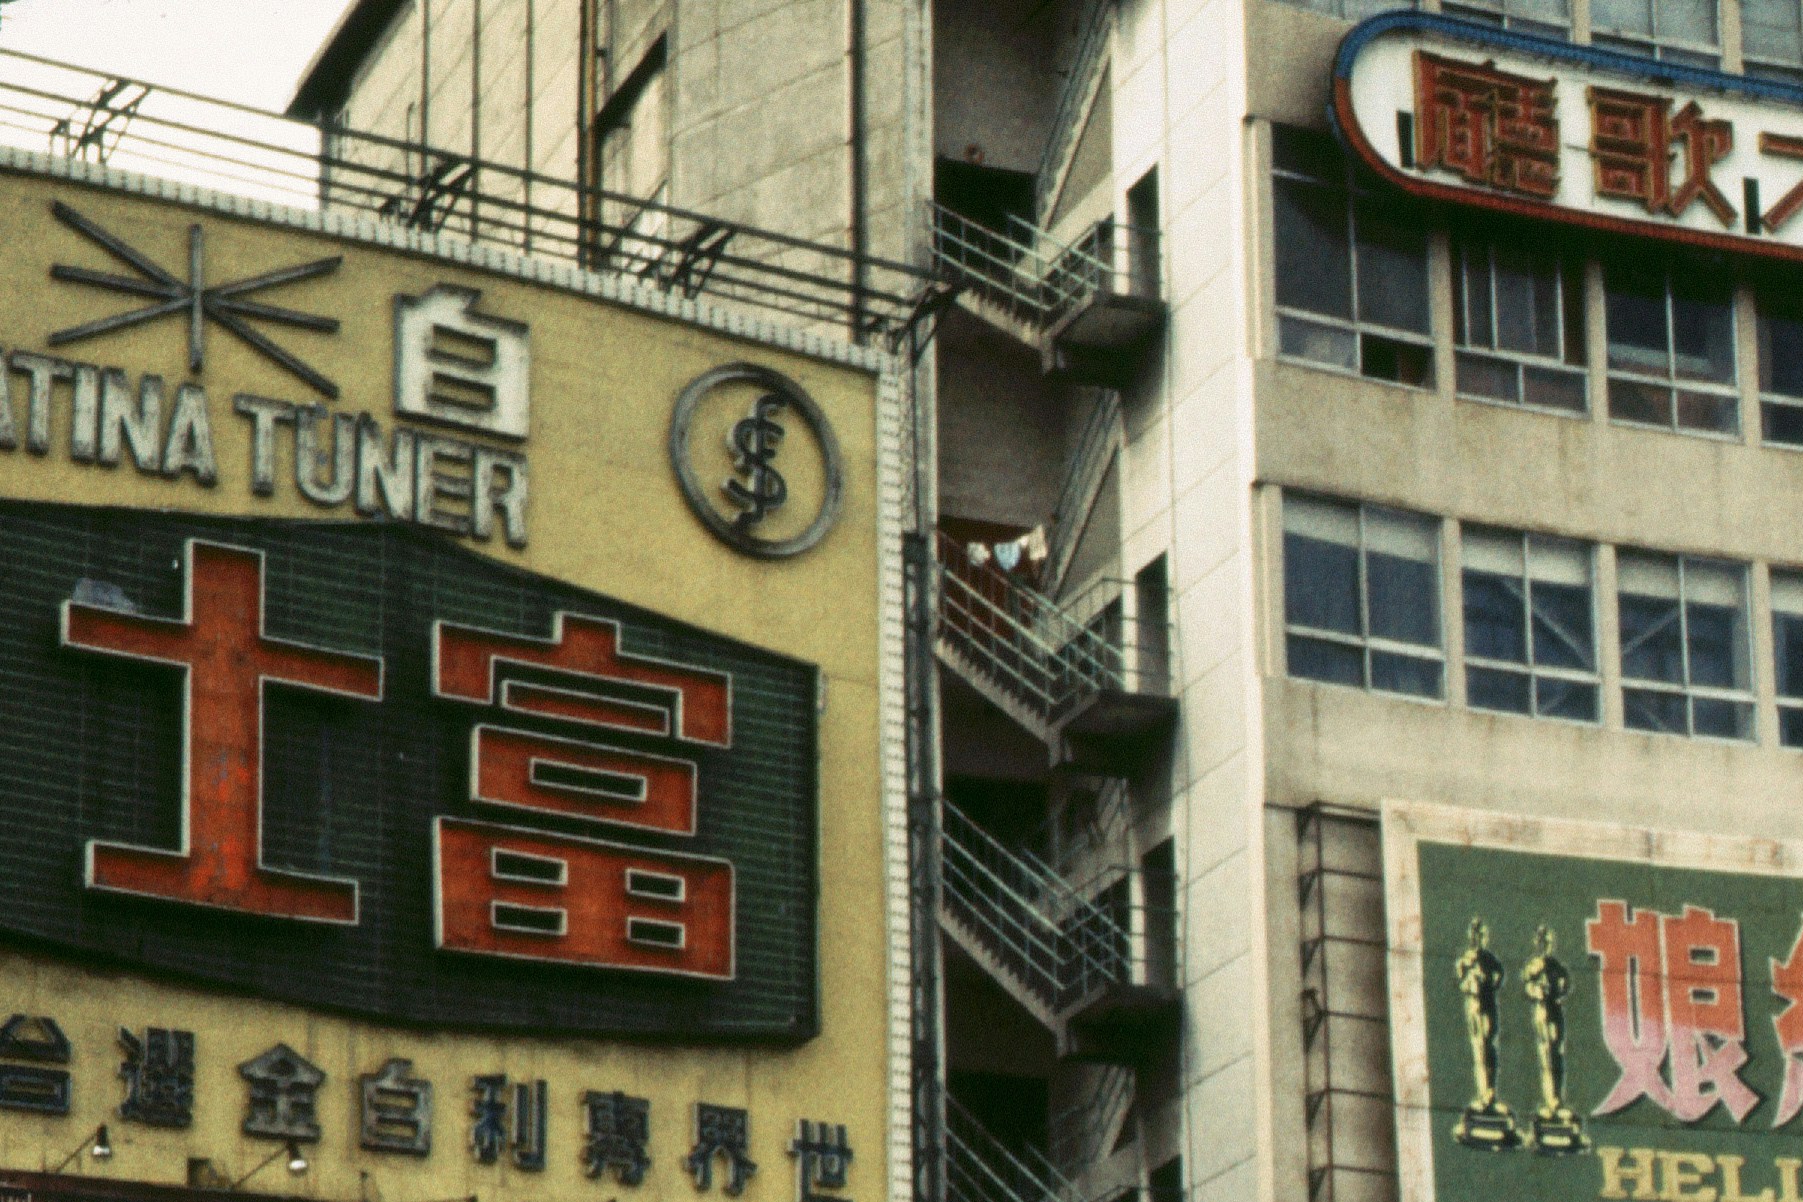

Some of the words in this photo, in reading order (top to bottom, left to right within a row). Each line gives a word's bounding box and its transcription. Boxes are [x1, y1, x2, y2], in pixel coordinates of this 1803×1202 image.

[0, 350, 218, 488] TINA
[234, 392, 528, 550] TUNER
[60, 538, 736, 982] 富士
